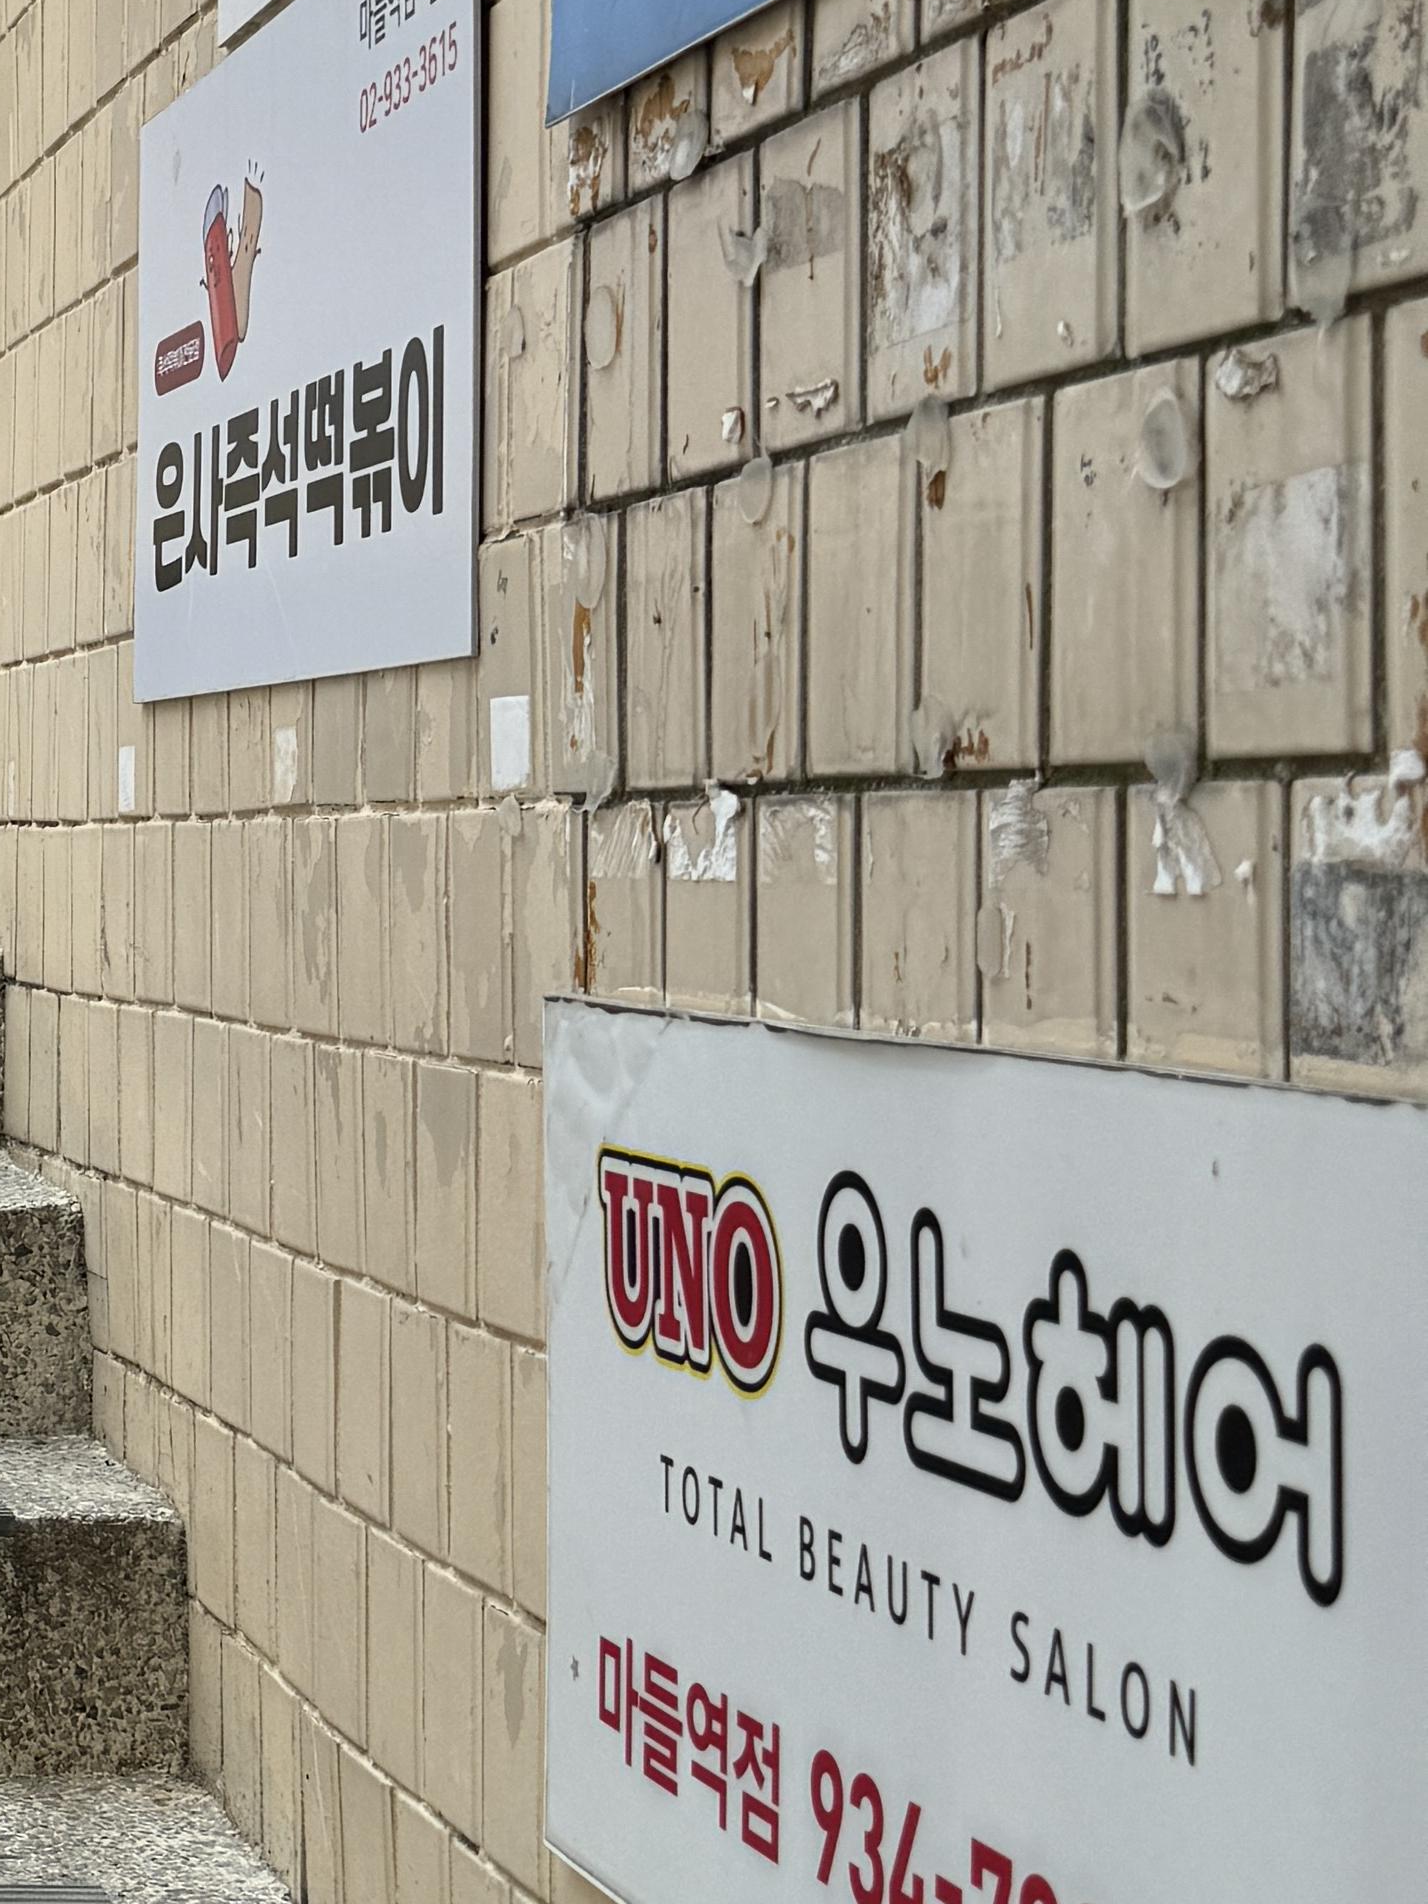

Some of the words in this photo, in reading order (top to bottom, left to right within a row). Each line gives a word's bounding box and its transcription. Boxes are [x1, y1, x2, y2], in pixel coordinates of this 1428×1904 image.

[359, 20, 458, 134] 02-933-3615
[153, 324, 445, 593] 은사즉석떡볶이
[596, 1143, 784, 1402] UNO
[804, 1168, 1345, 1610] 우노헤어
[660, 1454, 773, 1564] TOTAL
[799, 1514, 976, 1660] BEAUTY
[1010, 1609, 1200, 1769] SALON
[597, 1634, 782, 1866] 마들역점
